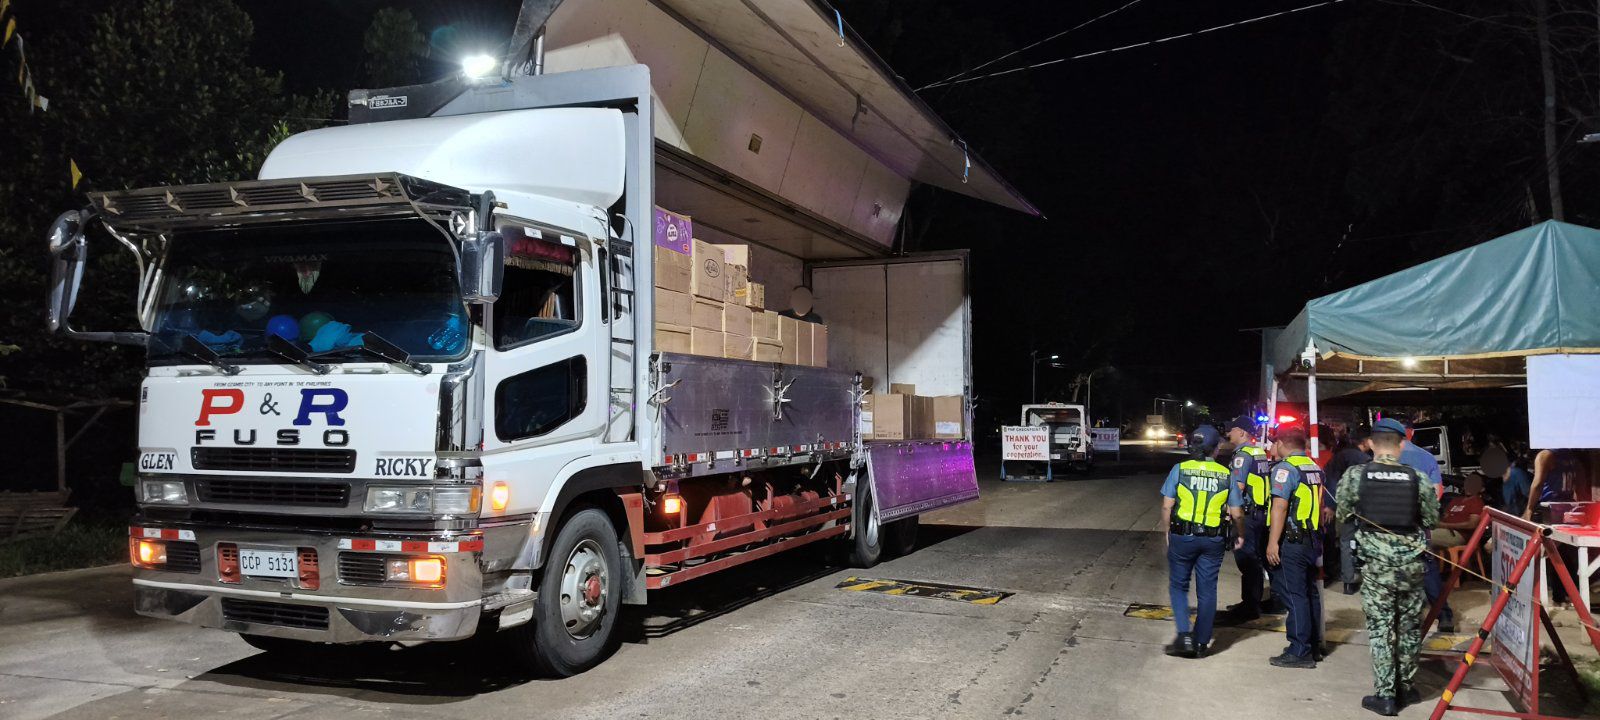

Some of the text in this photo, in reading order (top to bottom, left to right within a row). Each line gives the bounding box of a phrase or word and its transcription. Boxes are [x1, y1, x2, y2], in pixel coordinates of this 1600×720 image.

[195, 387, 349, 426] P & R
[195, 429, 350, 447] FUSO
[1005, 434, 1047, 443] THANK YOU
[1024, 444, 1039, 452] your
[141, 453, 175, 470] GLEN
[374, 457, 433, 477] RICKY
[1190, 476, 1219, 492] PULIS
[1367, 471, 1410, 481] POLICE
[241, 555, 295, 572] CCP 5131
